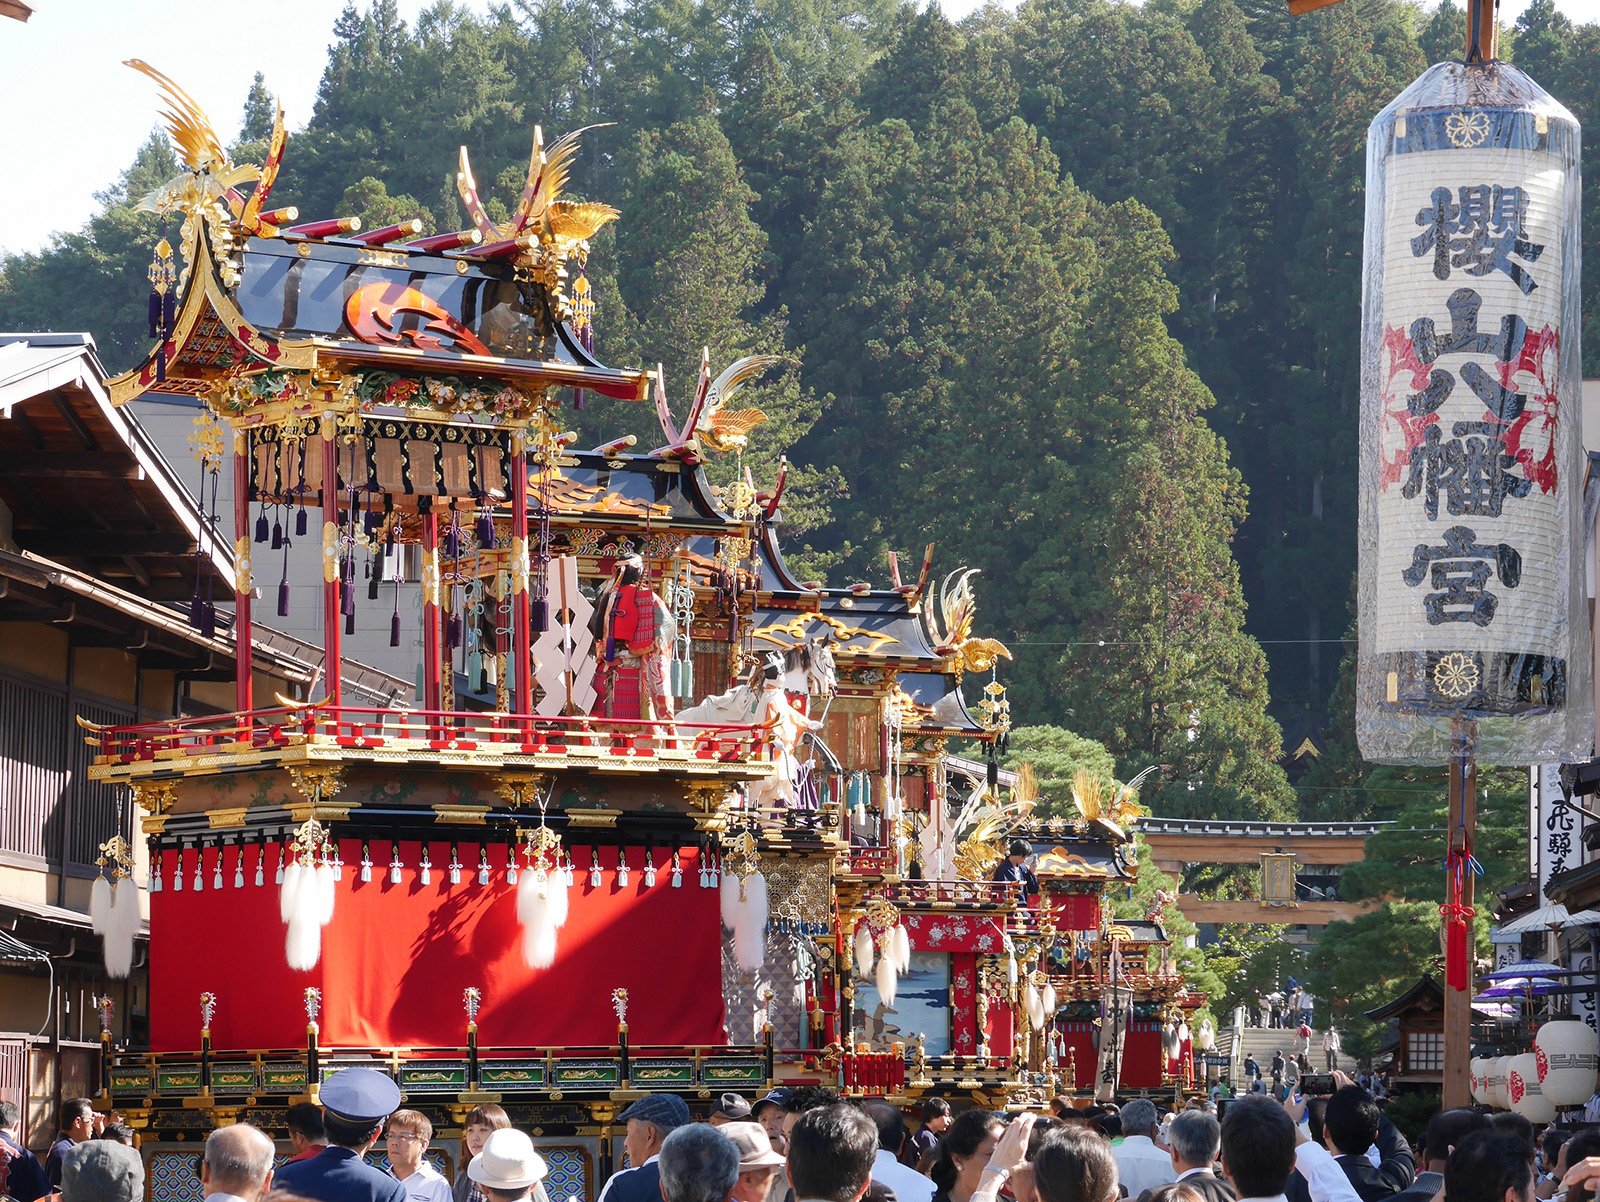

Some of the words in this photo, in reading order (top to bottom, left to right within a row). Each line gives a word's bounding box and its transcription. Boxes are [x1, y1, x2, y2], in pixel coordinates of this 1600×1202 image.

[1400, 183, 1545, 628] 櫻山八幡宮
